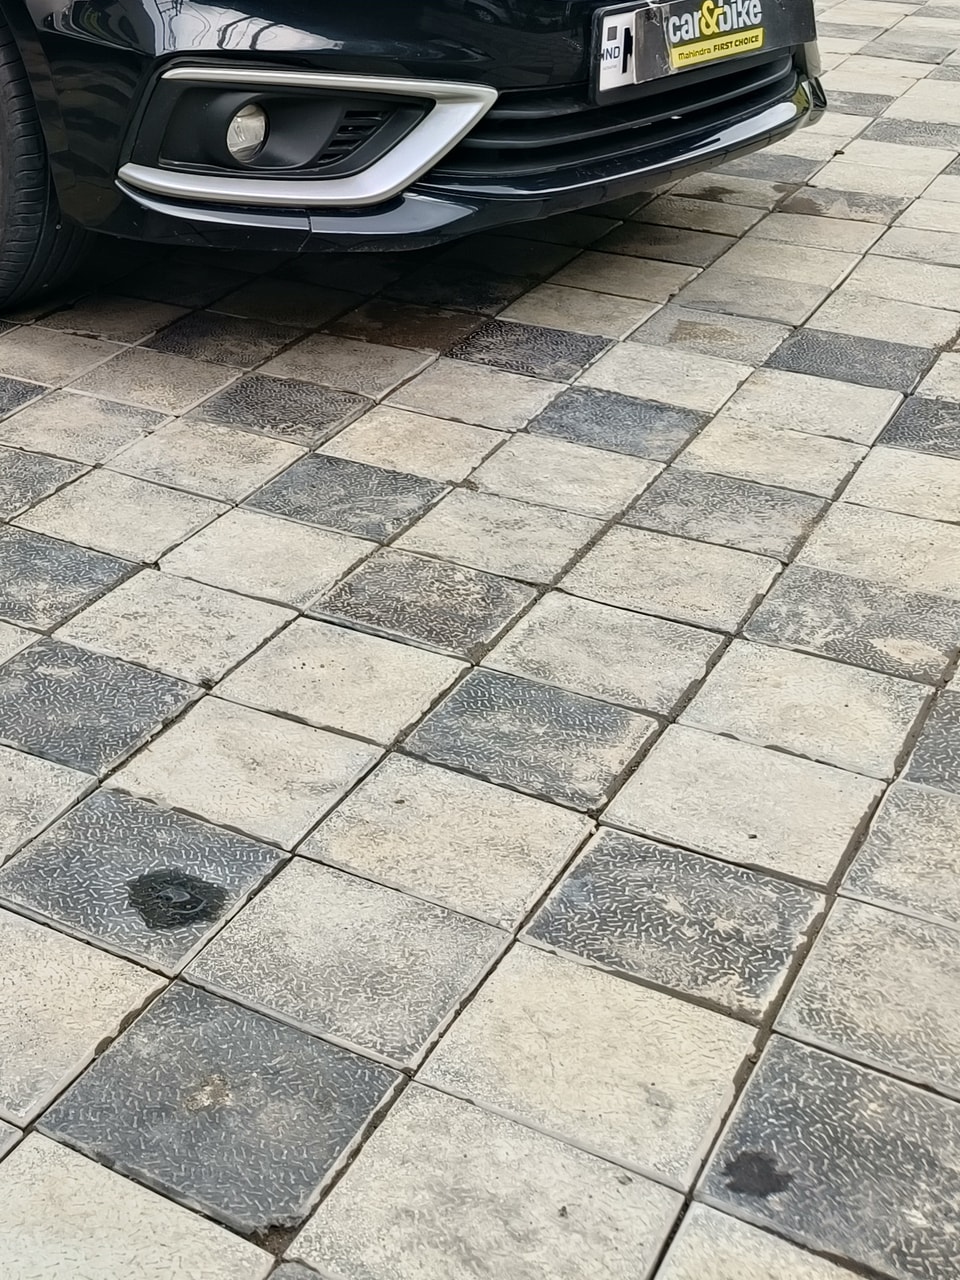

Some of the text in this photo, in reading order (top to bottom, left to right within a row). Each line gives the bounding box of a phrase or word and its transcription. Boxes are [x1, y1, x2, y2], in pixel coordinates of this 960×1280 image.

[678, 35, 759, 61] Mahindra FIRST CHOICE
